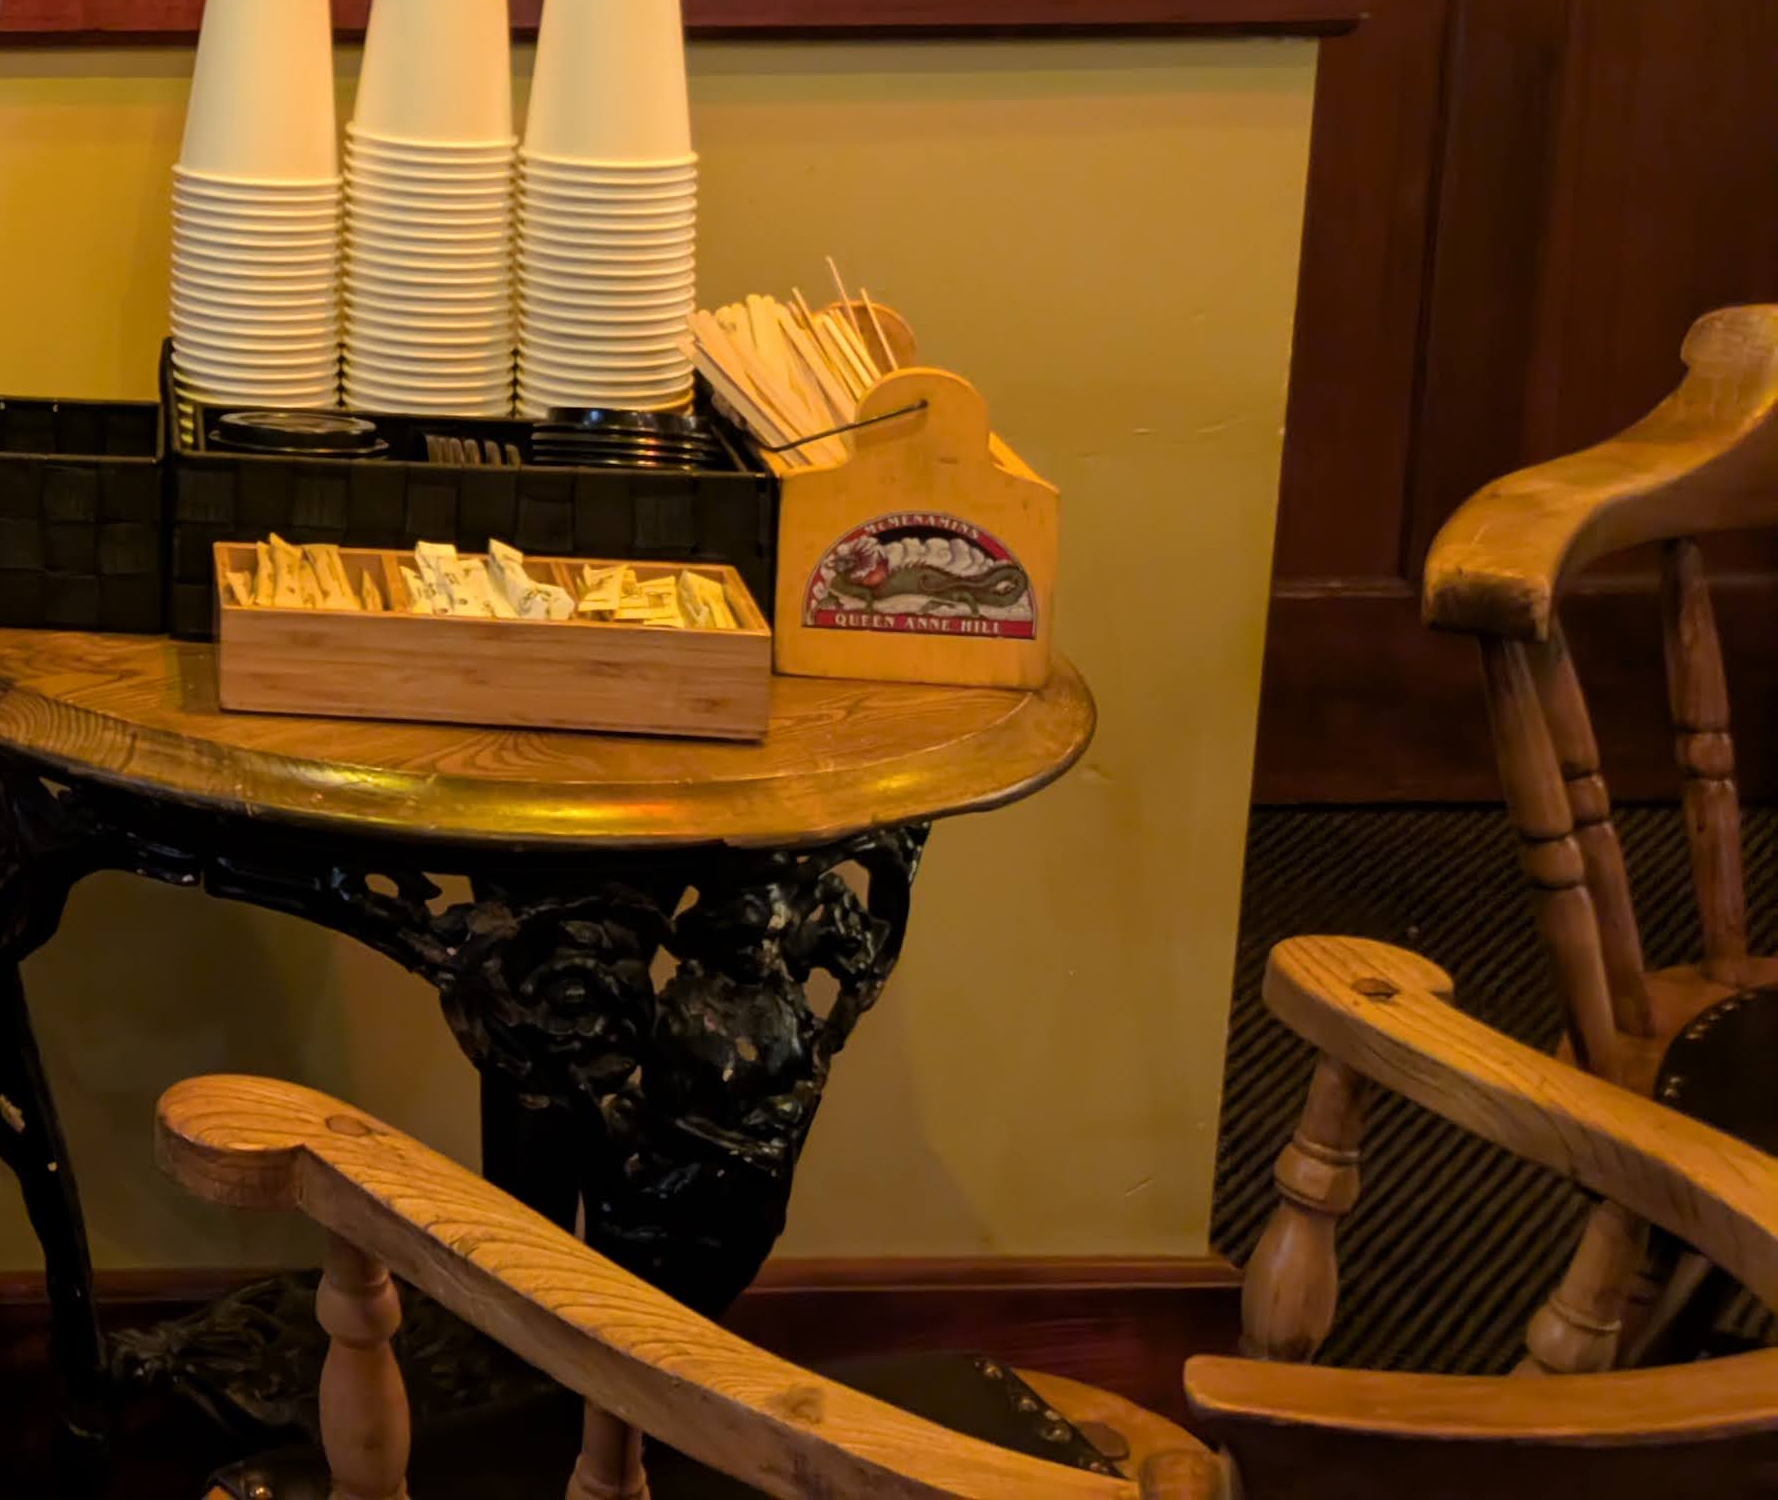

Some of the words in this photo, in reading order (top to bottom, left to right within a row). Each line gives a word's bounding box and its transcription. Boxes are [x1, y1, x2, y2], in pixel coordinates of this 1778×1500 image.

[834, 612, 895, 627] QUEEN
[903, 616, 951, 631] ANNE
[960, 619, 1001, 634] HILL
